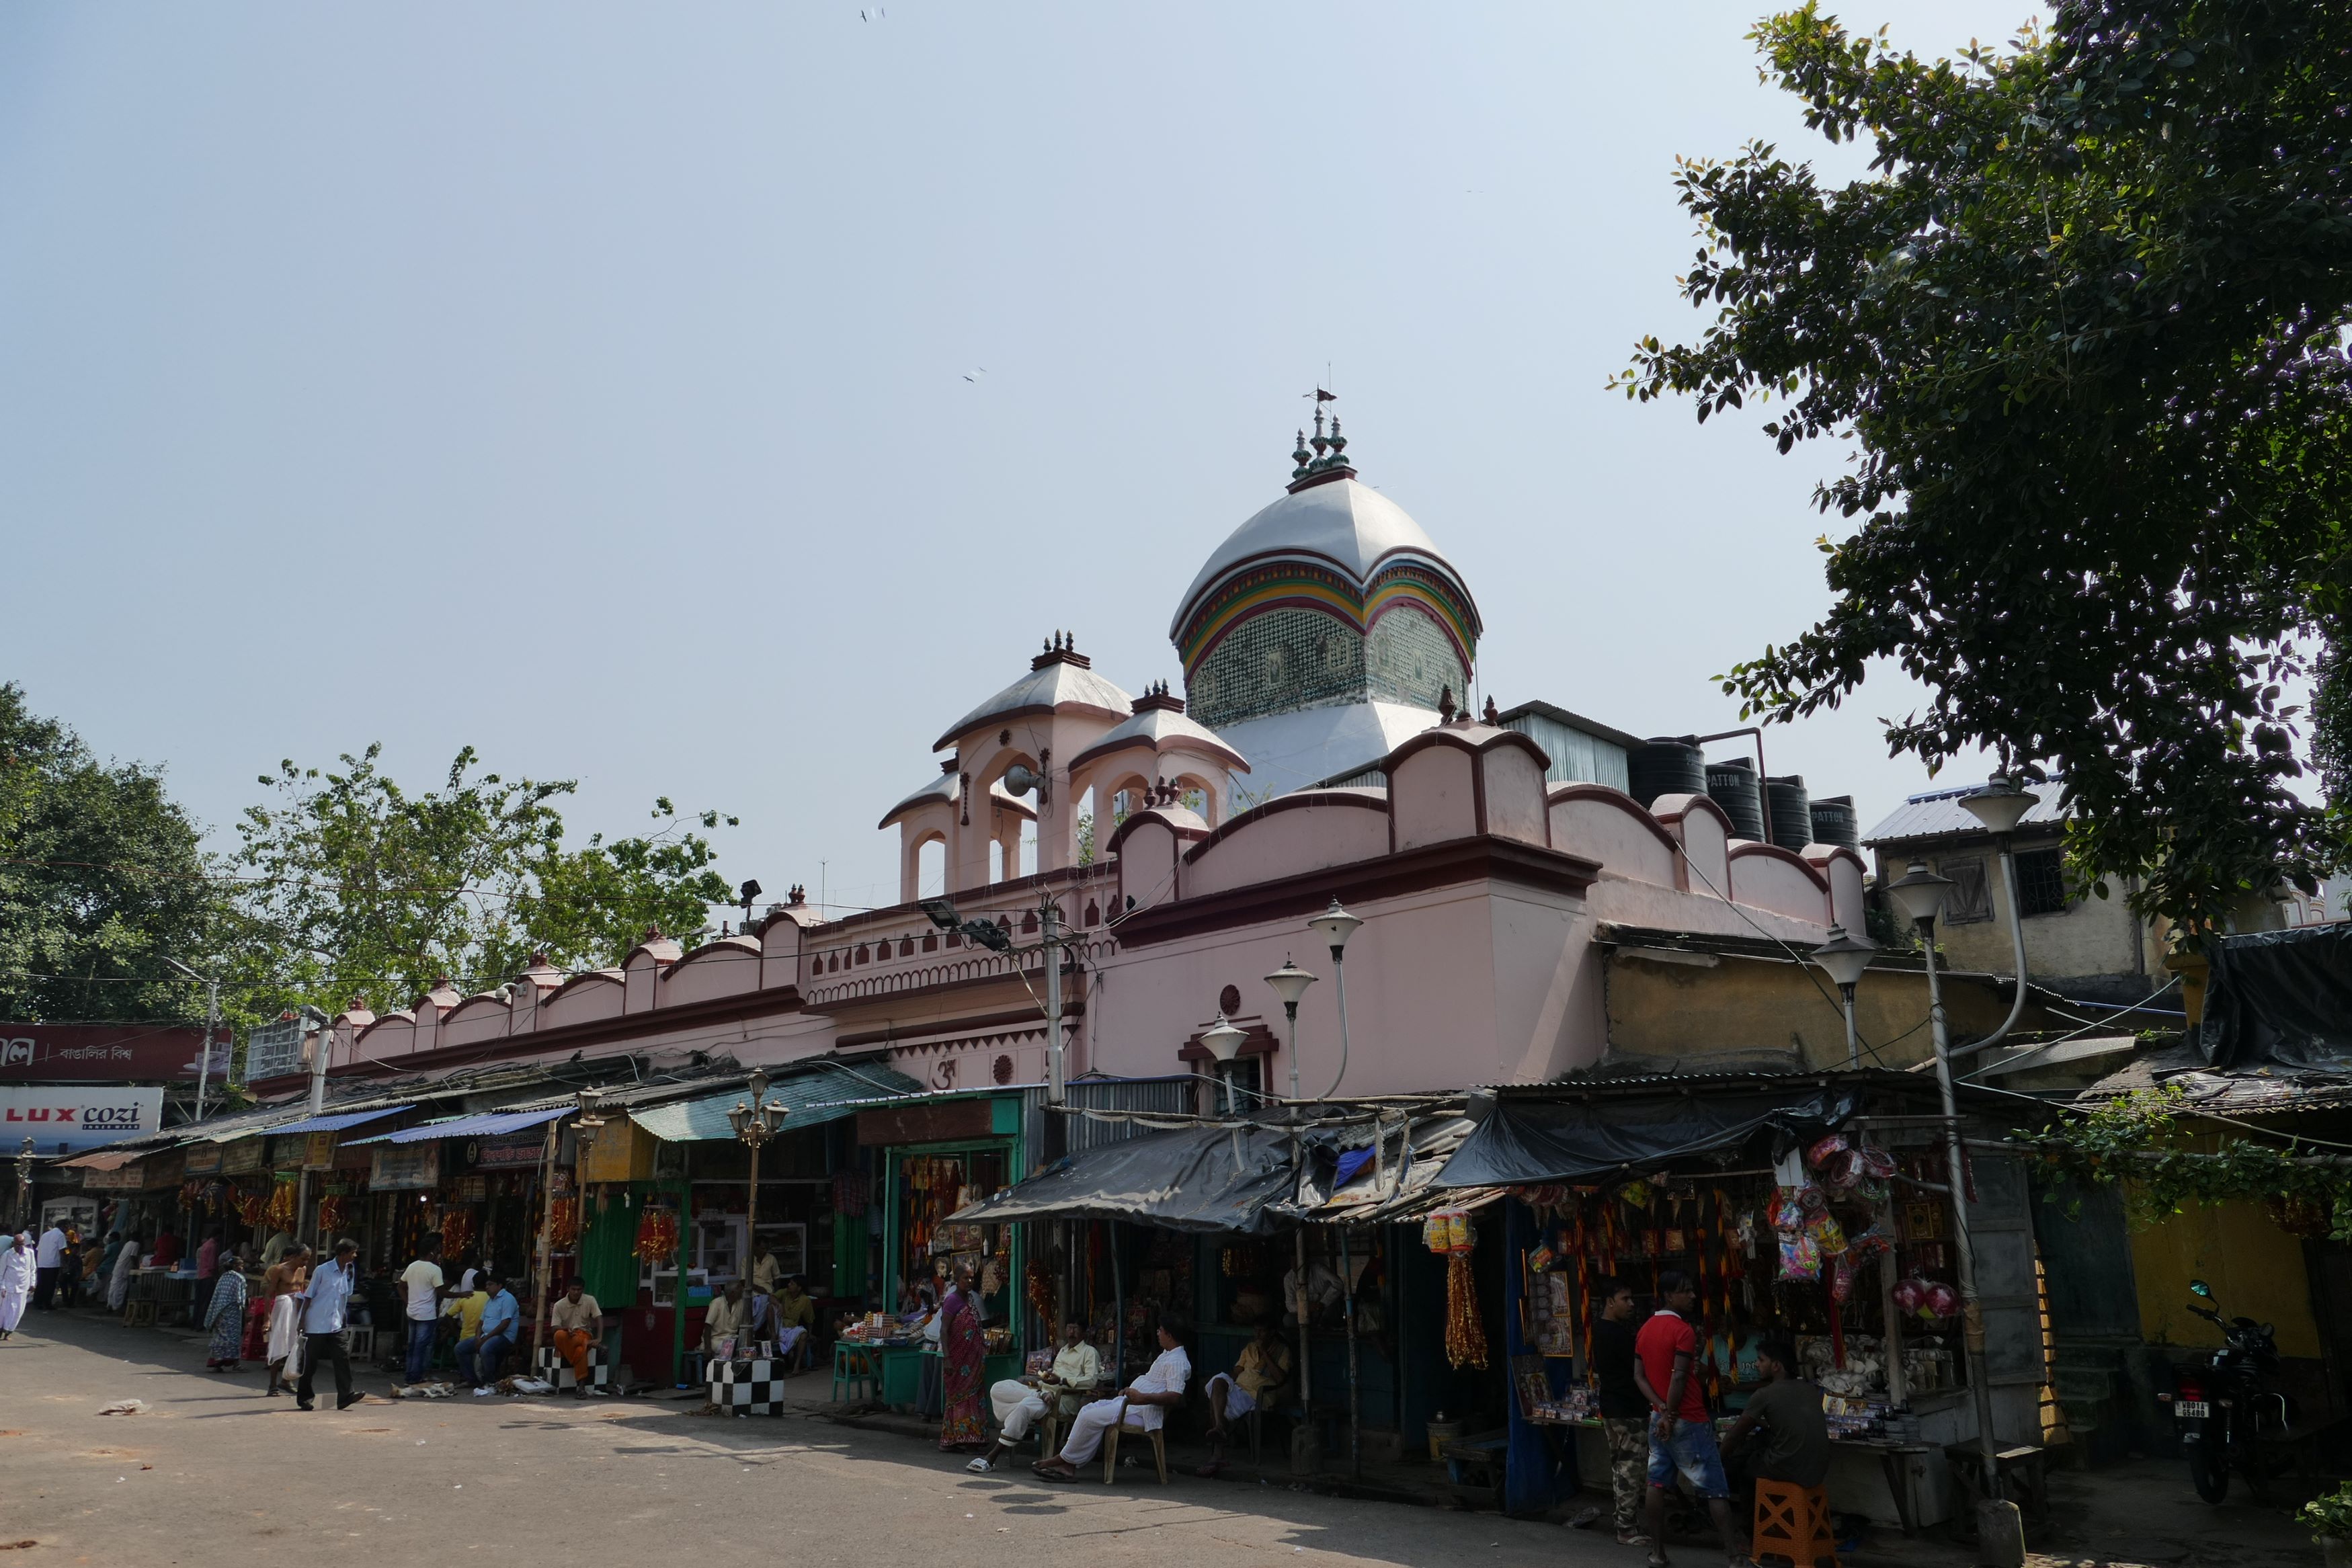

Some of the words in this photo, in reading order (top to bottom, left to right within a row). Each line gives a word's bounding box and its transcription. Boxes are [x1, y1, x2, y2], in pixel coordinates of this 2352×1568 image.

[1707, 774, 1740, 787] PATTON
[1811, 811, 1843, 823] PATTON
[6, 1108, 77, 1122] LUX
[83, 1102, 140, 1122] cozi
[493, 1134, 517, 1145] SHAKTI
